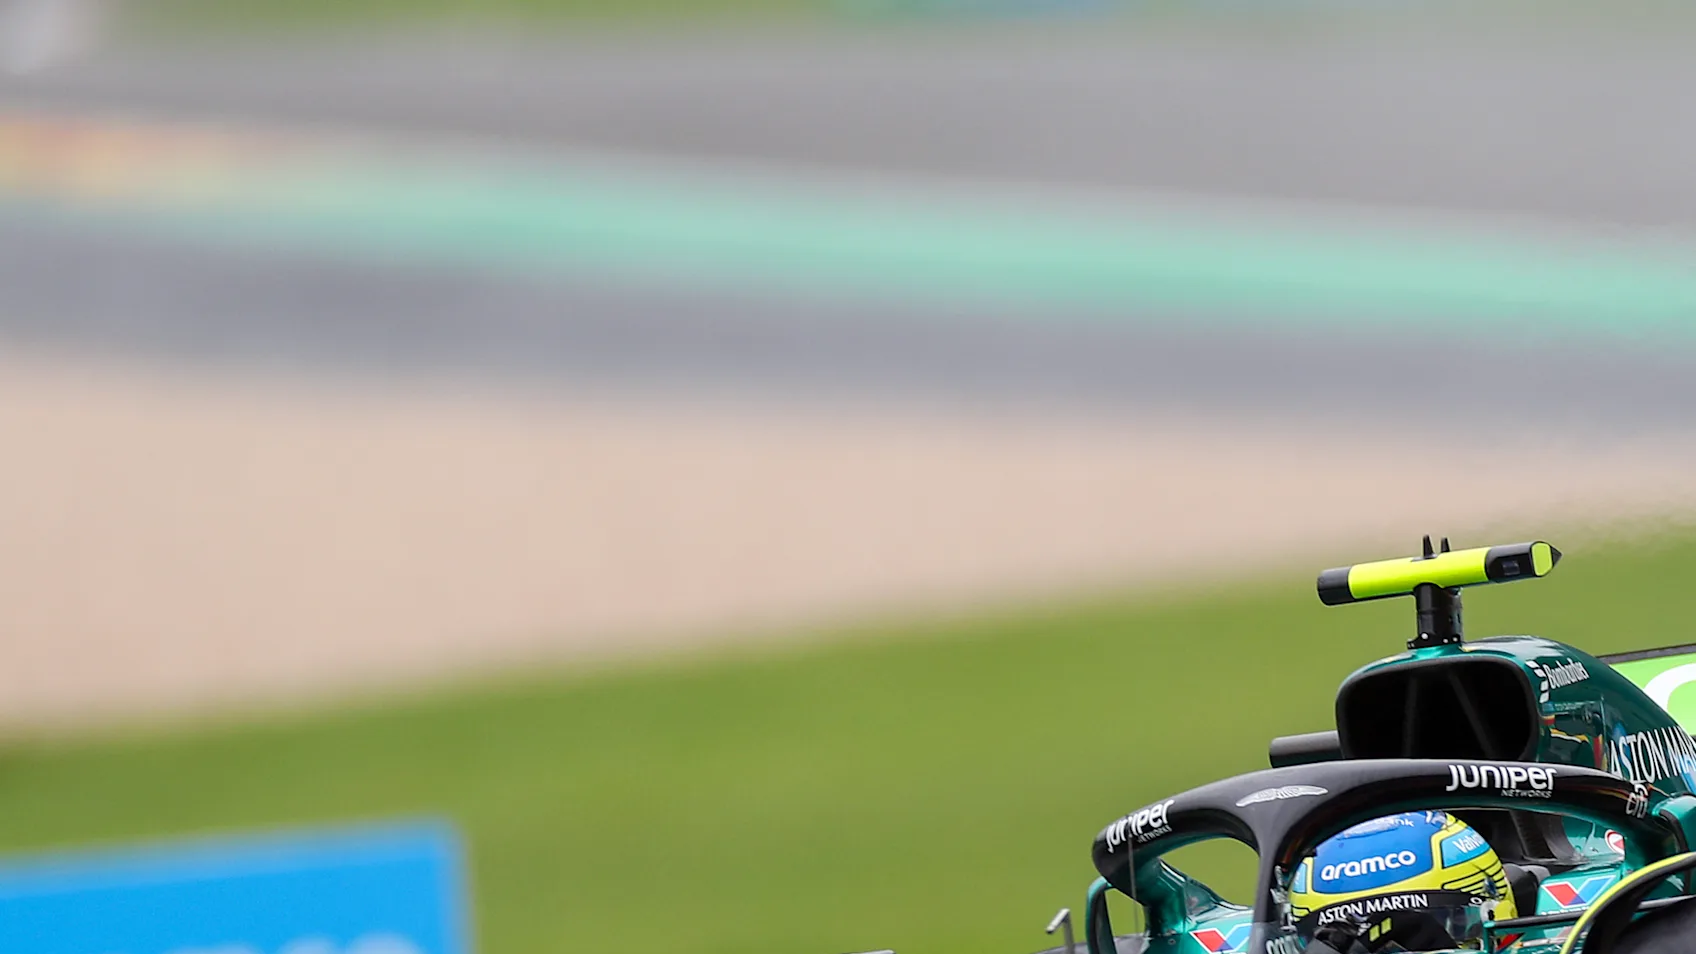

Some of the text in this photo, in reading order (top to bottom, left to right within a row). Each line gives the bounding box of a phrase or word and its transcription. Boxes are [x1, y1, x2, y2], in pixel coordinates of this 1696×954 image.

[1610, 730, 1671, 784] ASTON
[1501, 788, 1553, 799] NETWORKS
[1320, 850, 1417, 881] aramco
[1317, 893, 1429, 926] ASTON MARTIN
